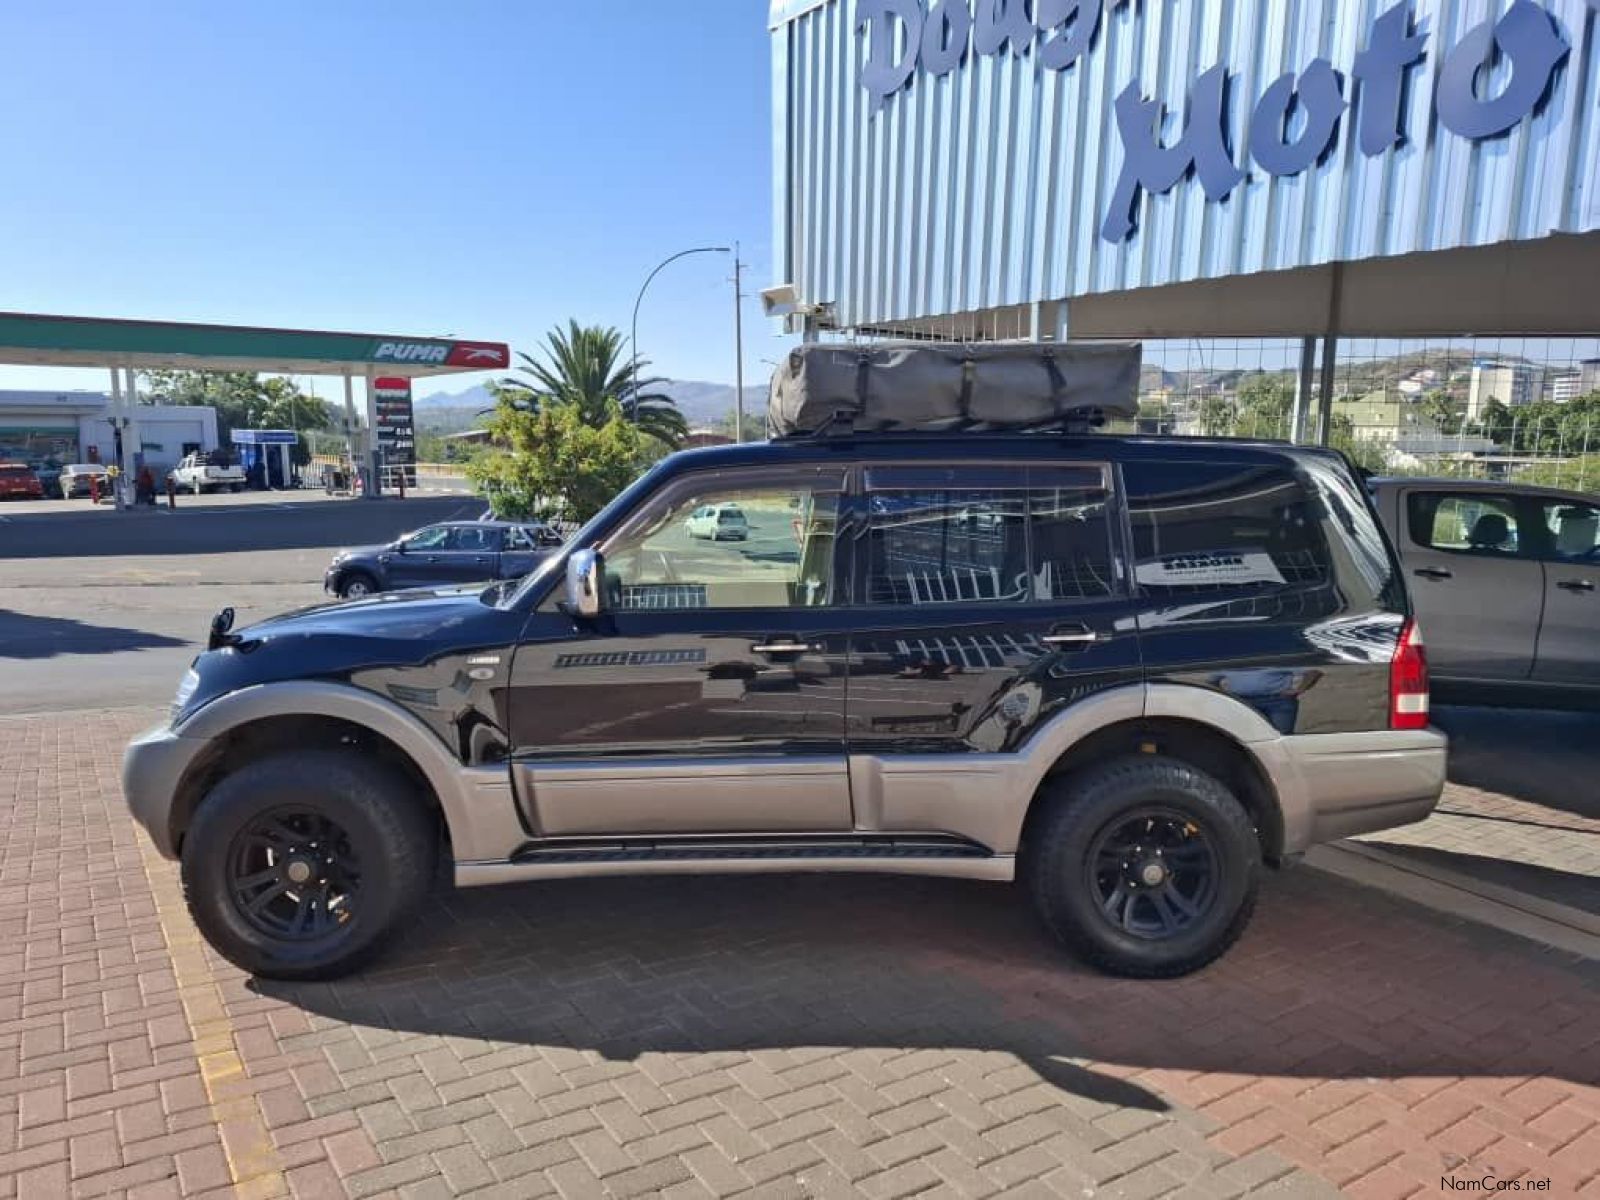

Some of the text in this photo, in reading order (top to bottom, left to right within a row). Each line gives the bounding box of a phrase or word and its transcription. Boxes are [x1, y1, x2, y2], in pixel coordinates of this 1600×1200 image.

[855, 0, 1122, 108] Doug
[1102, 0, 1600, 243] Moto
[374, 343, 448, 362] PUMA
